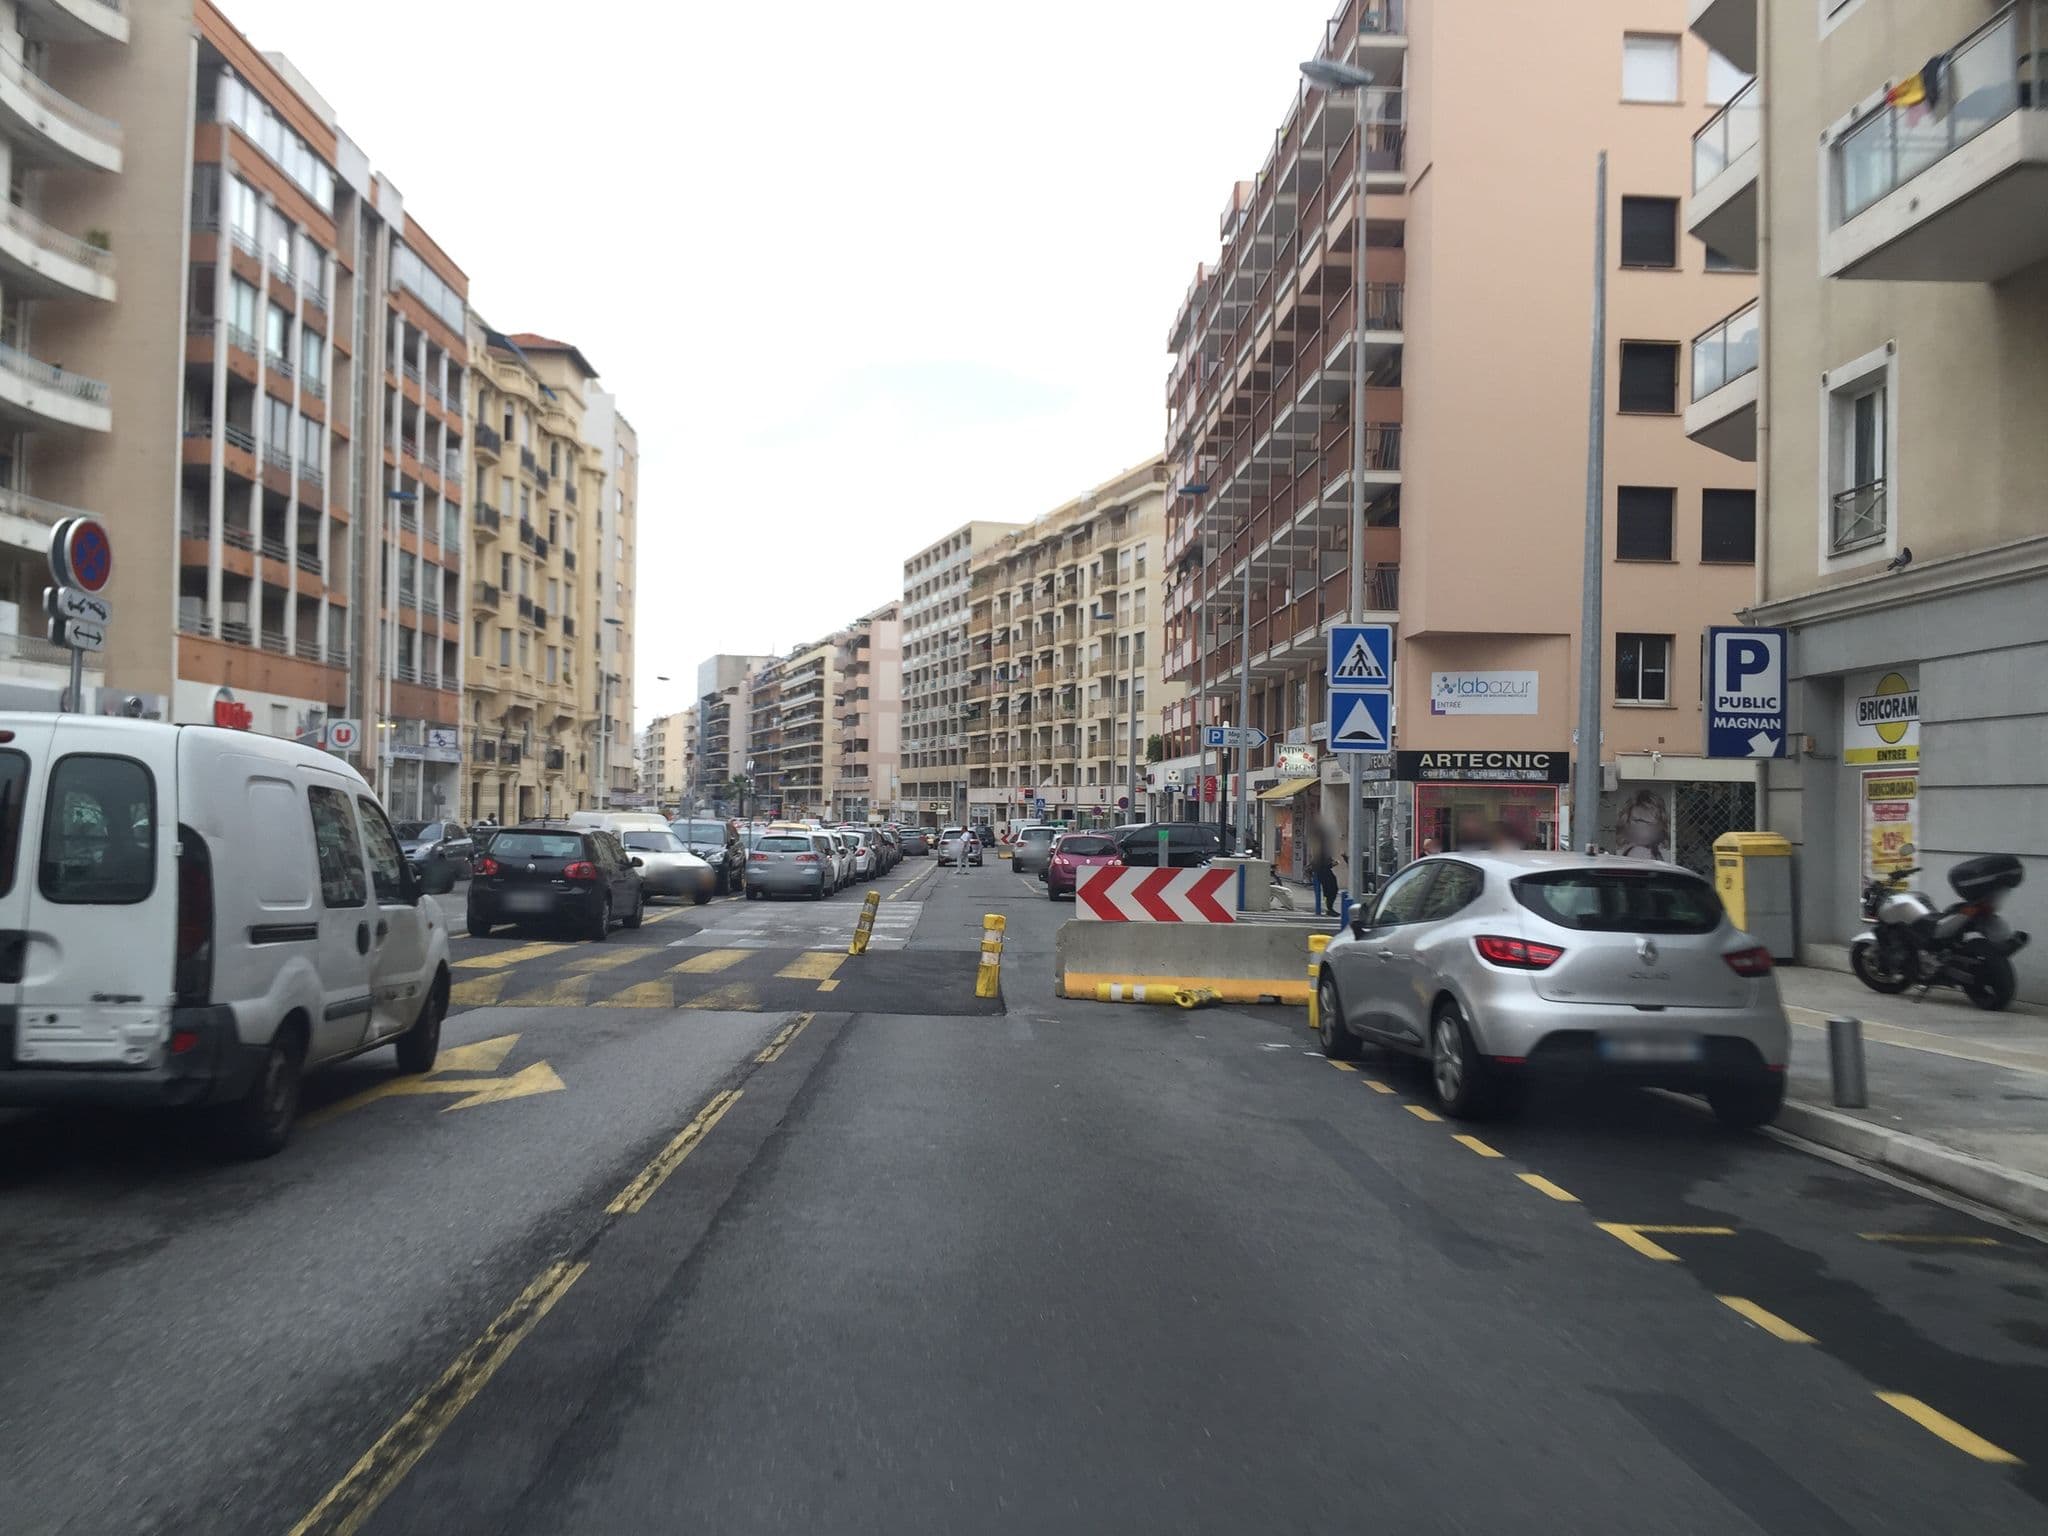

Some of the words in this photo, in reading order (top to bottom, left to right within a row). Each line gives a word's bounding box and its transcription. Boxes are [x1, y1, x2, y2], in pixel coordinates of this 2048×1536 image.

[1726, 639, 1770, 692] P
[1457, 677, 1531, 694] labazur
[1718, 696, 1777, 709] PUBLIC
[1860, 696, 1920, 721] BRICORAM
[1713, 716, 1781, 729] MAGNAN
[336, 729, 352, 743] U
[1211, 731, 1221, 742] P
[1419, 753, 1550, 768] ARTECNIC
